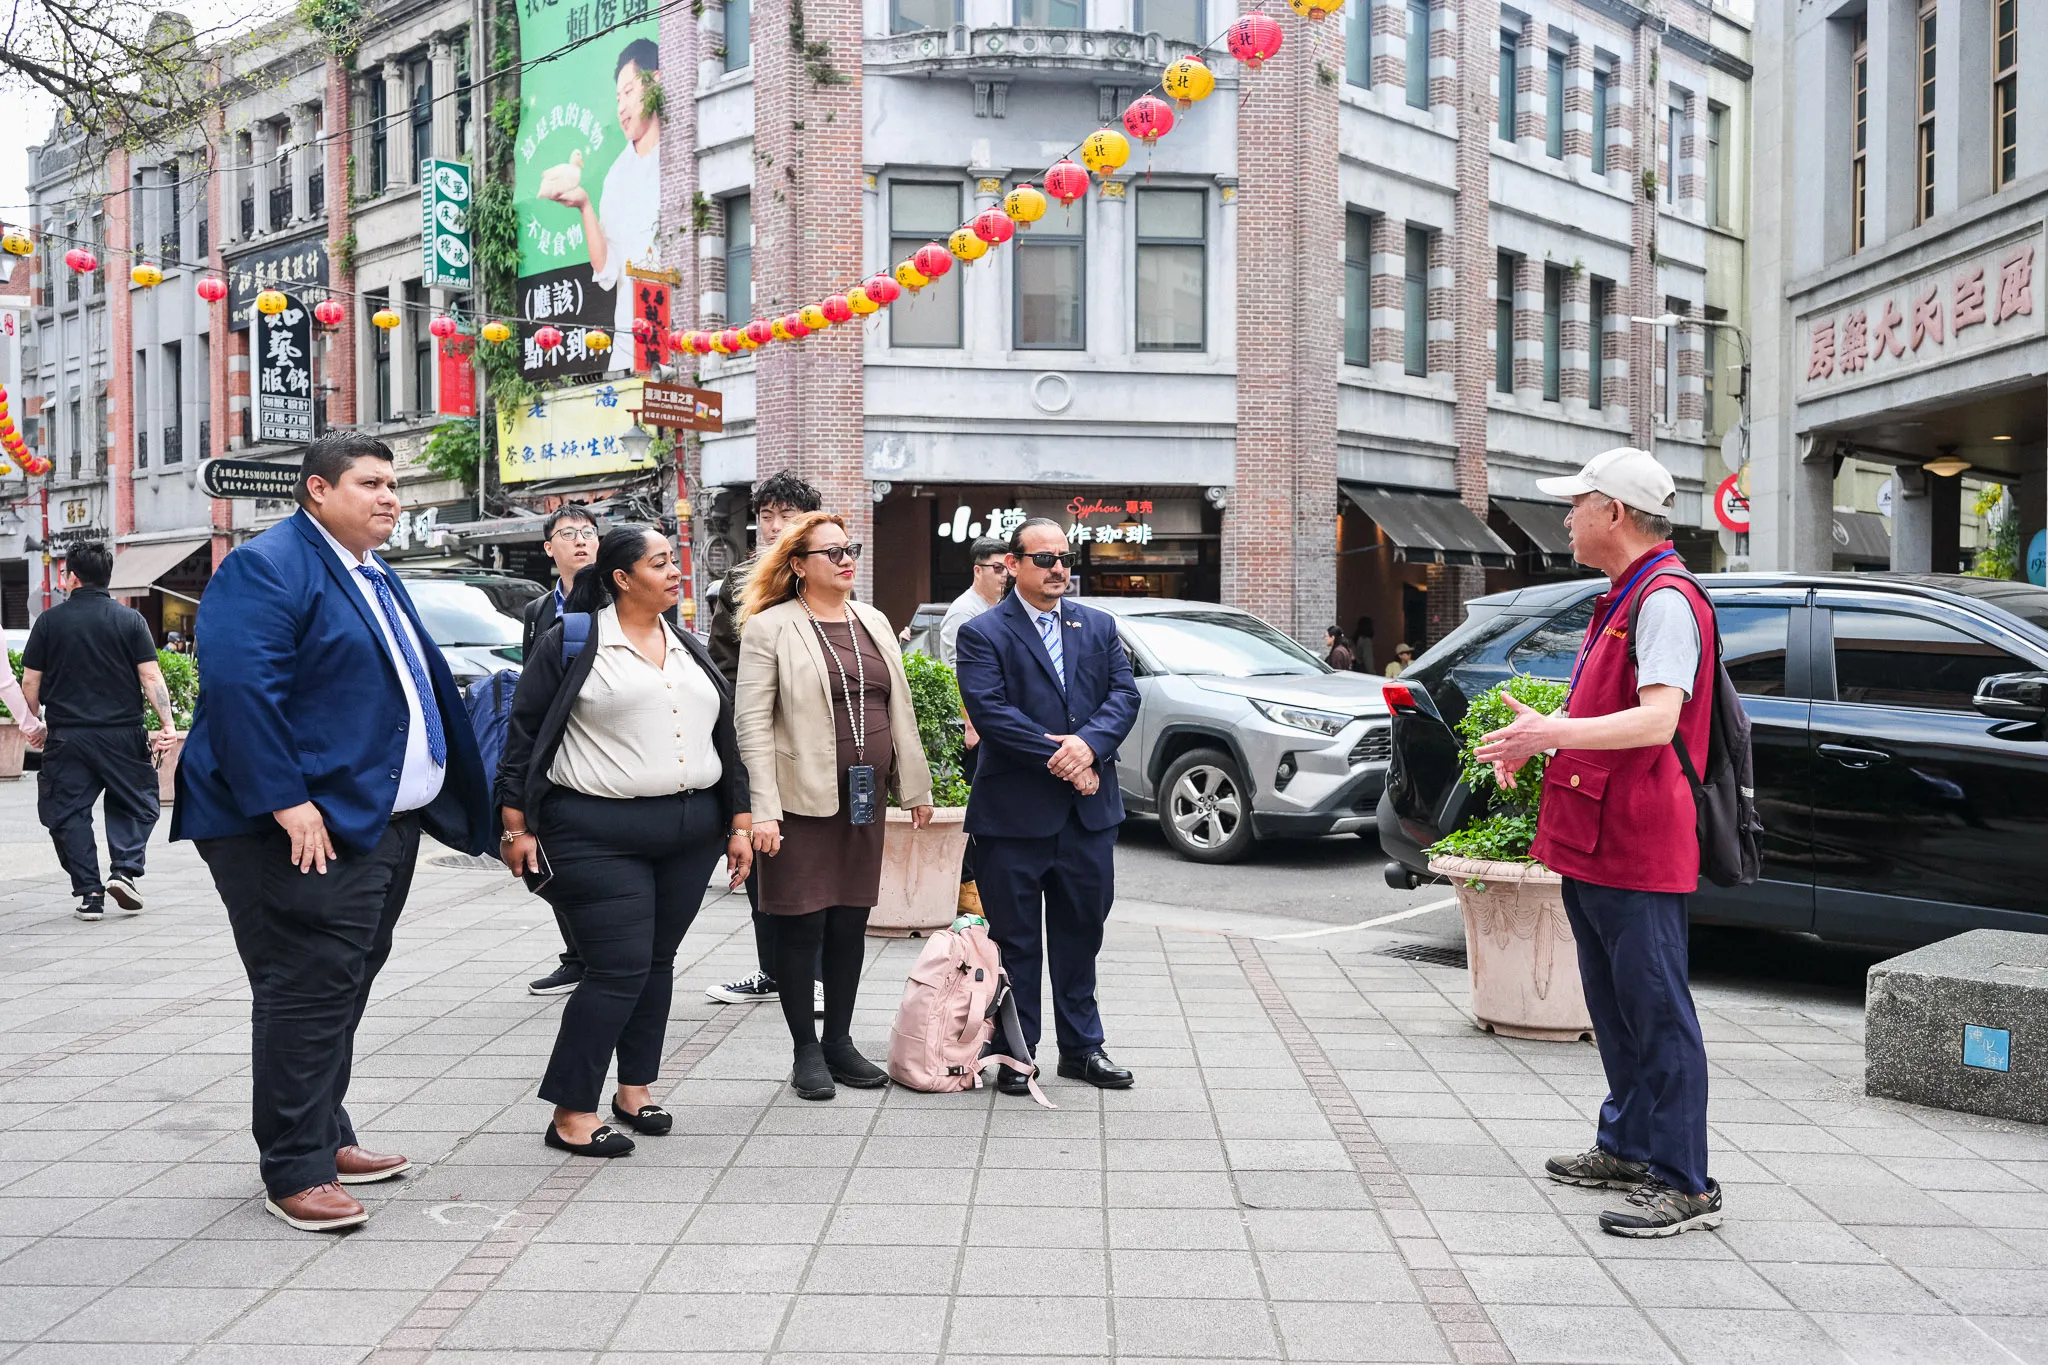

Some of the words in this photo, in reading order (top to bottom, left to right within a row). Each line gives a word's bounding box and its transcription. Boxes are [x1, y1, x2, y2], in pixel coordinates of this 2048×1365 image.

[1178, 63, 1191, 88] 台北
[1139, 101, 1151, 123] 台北
[521, 102, 604, 164] 這是我的寵物
[1094, 134, 1106, 156] 台北
[1011, 194, 1020, 214] 台北
[527, 214, 583, 256] 不是食物
[981, 215, 991, 234] 台北
[958, 234, 967, 252] 台北
[525, 278, 583, 321] (應該)
[1807, 245, 2034, 381] 屈臣氏大藥房
[1066, 496, 1121, 519] Syphon
